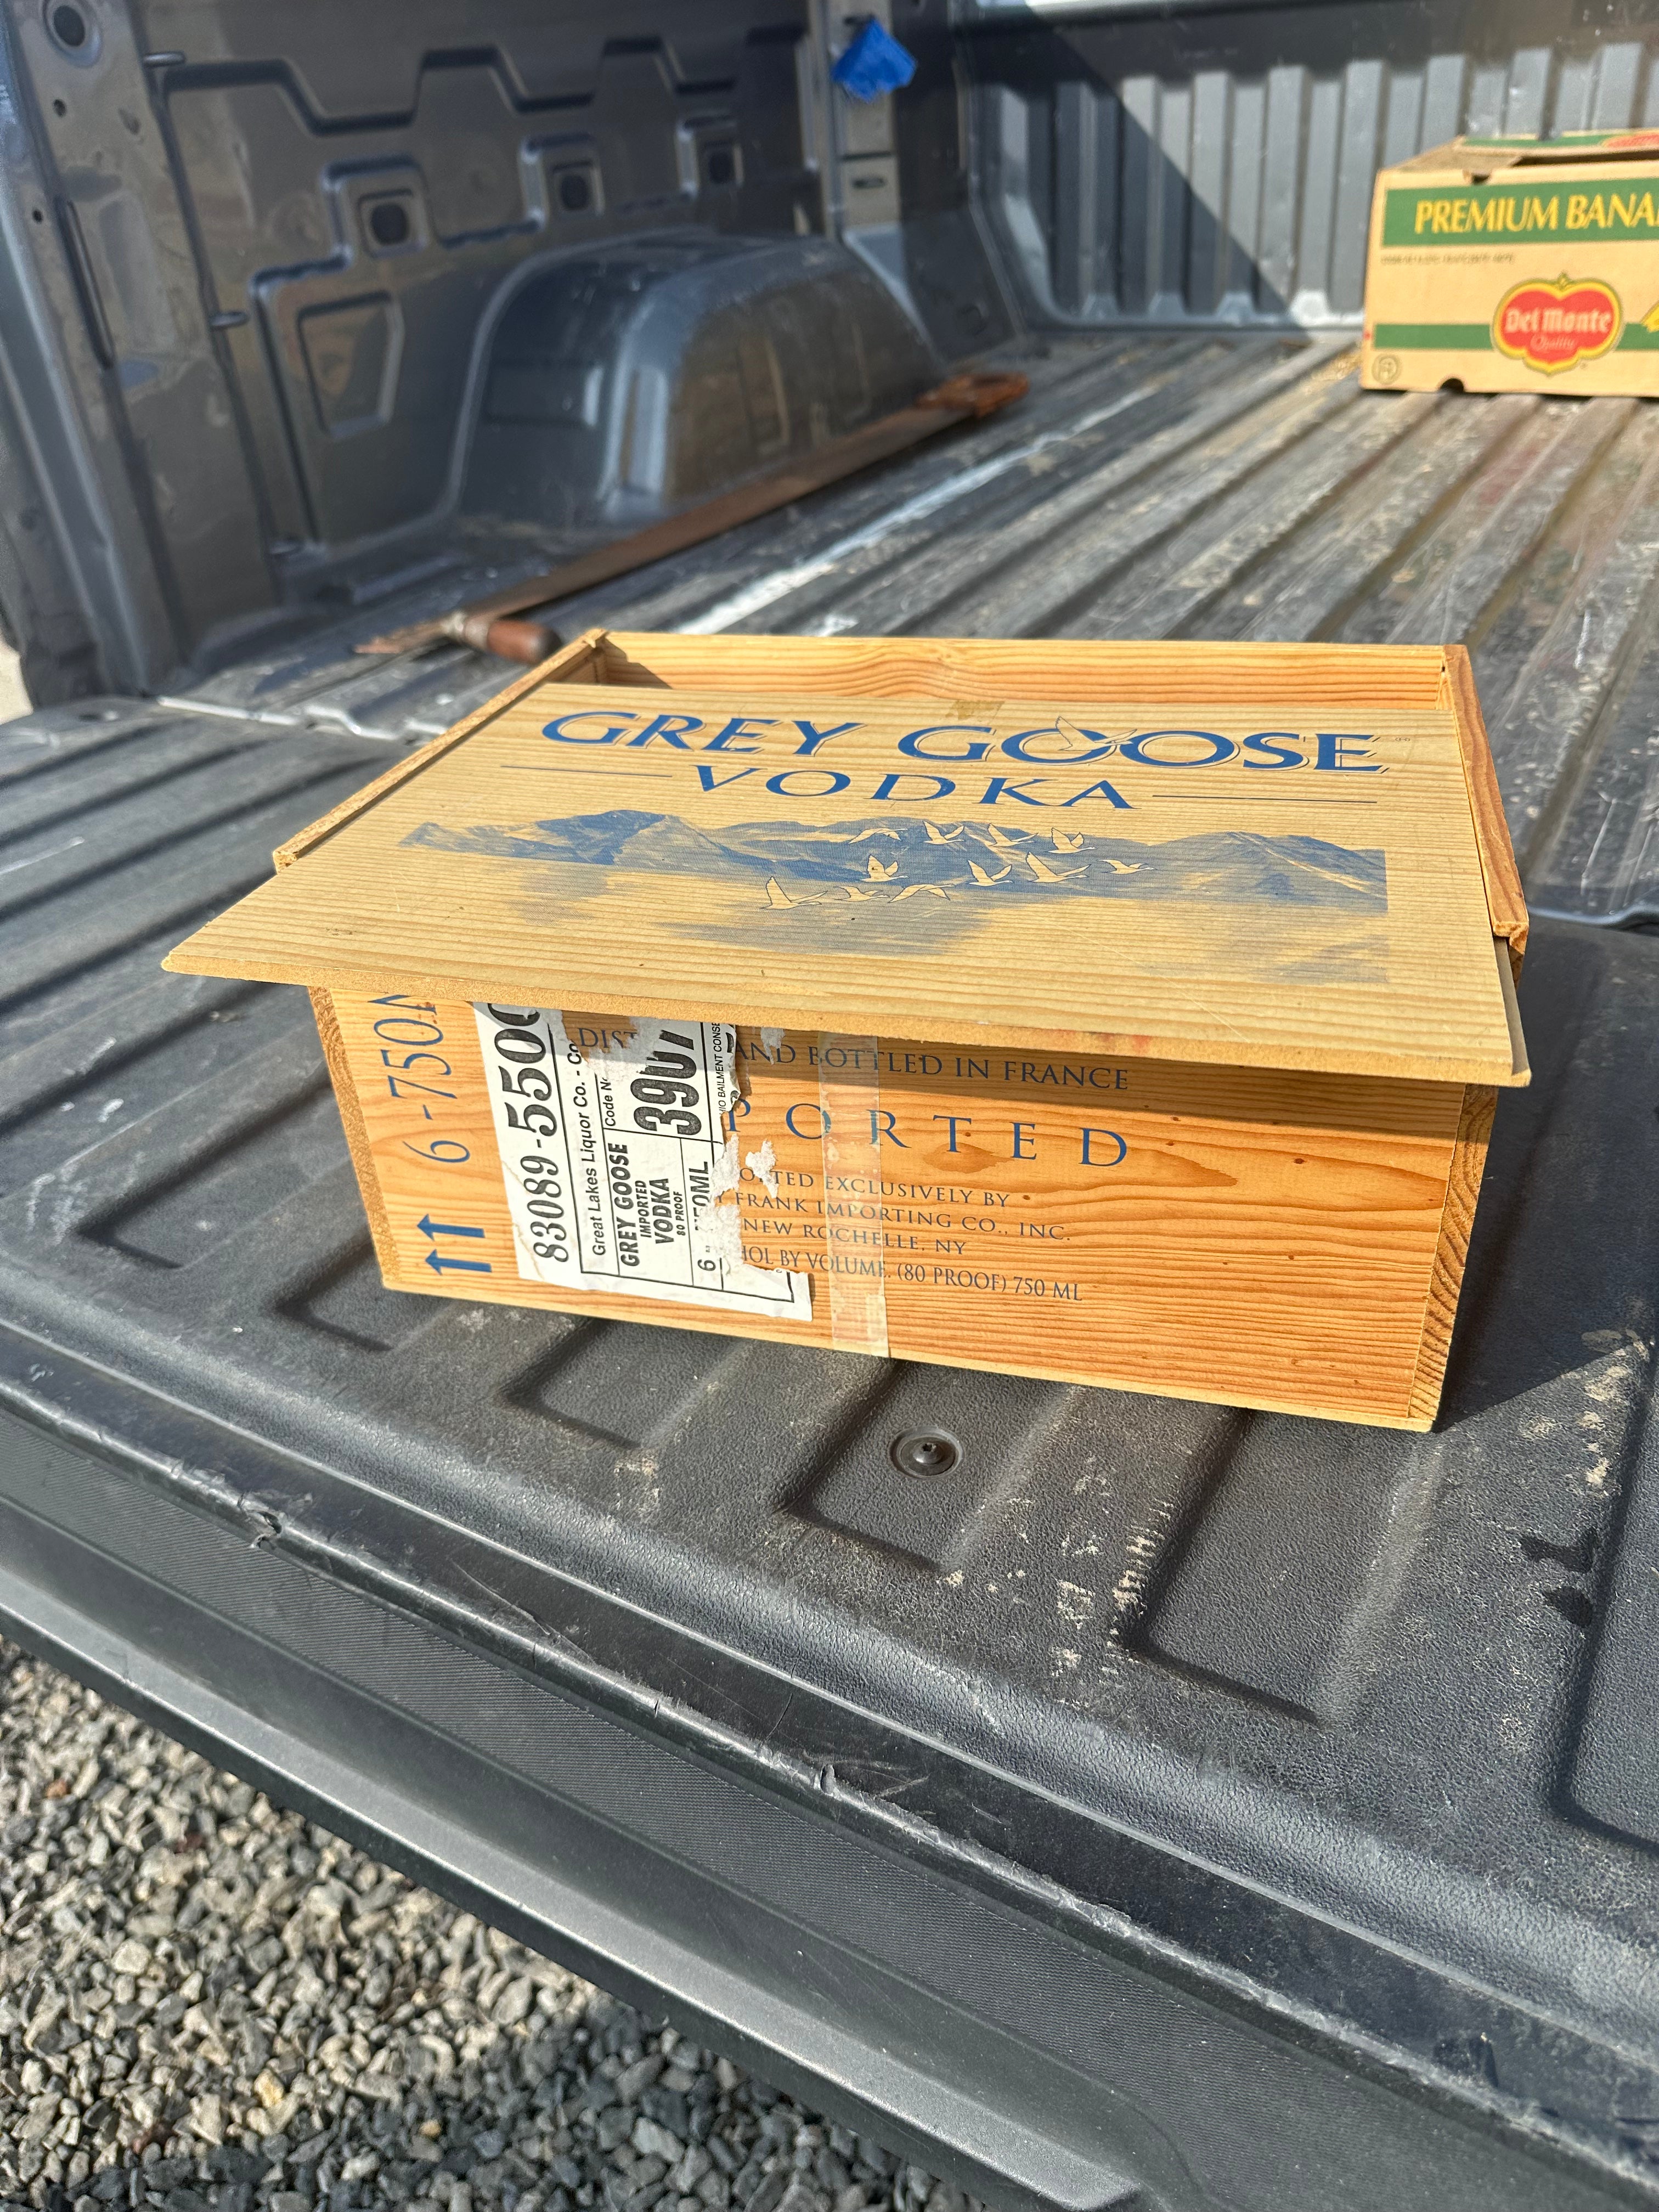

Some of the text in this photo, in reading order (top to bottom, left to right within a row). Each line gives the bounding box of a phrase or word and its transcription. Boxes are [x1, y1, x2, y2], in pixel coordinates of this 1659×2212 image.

[1414, 193, 1659, 234] PREMIUM BANA
[1505, 307, 1612, 333] Del Monte
[541, 711, 1390, 774] GREY GOOSE
[690, 765, 1143, 809] VODKA
[714, 1053, 726, 1097] BAILMENT
[808, 1046, 943, 1075] BOTTLED
[955, 1057, 989, 1079] IN
[1004, 1060, 1128, 1091] FRANCE
[573, 1082, 588, 1107] Co.
[602, 1095, 616, 1126] Code
[579, 1112, 597, 1162] Liquor
[585, 1167, 601, 1211] Lakes
[607, 1143, 640, 1266] GREY GOOSE
[635, 1180, 652, 1238] IMPORTED
[649, 1178, 674, 1244] VODKA
[825, 1176, 973, 1204] EXCLUSIVELY
[983, 1191, 1011, 1208] BY
[592, 1216, 606, 1255] Great
[673, 1191, 686, 1236] 80 PROOF
[735, 1192, 808, 1212] FRANK
[817, 1200, 952, 1228] IMPORTING
[961, 1216, 1008, 1235] CO.,
[1019, 1222, 1071, 1242] INC.
[743, 1217, 967, 1255] NEW ROCHELLE, NY
[780, 1249, 800, 1268] BY
[897, 1263, 926, 1283] (80
[934, 1266, 1007, 1294] PROOF)
[1013, 1276, 1045, 1297] 750
[1052, 1283, 1083, 1302] ML
